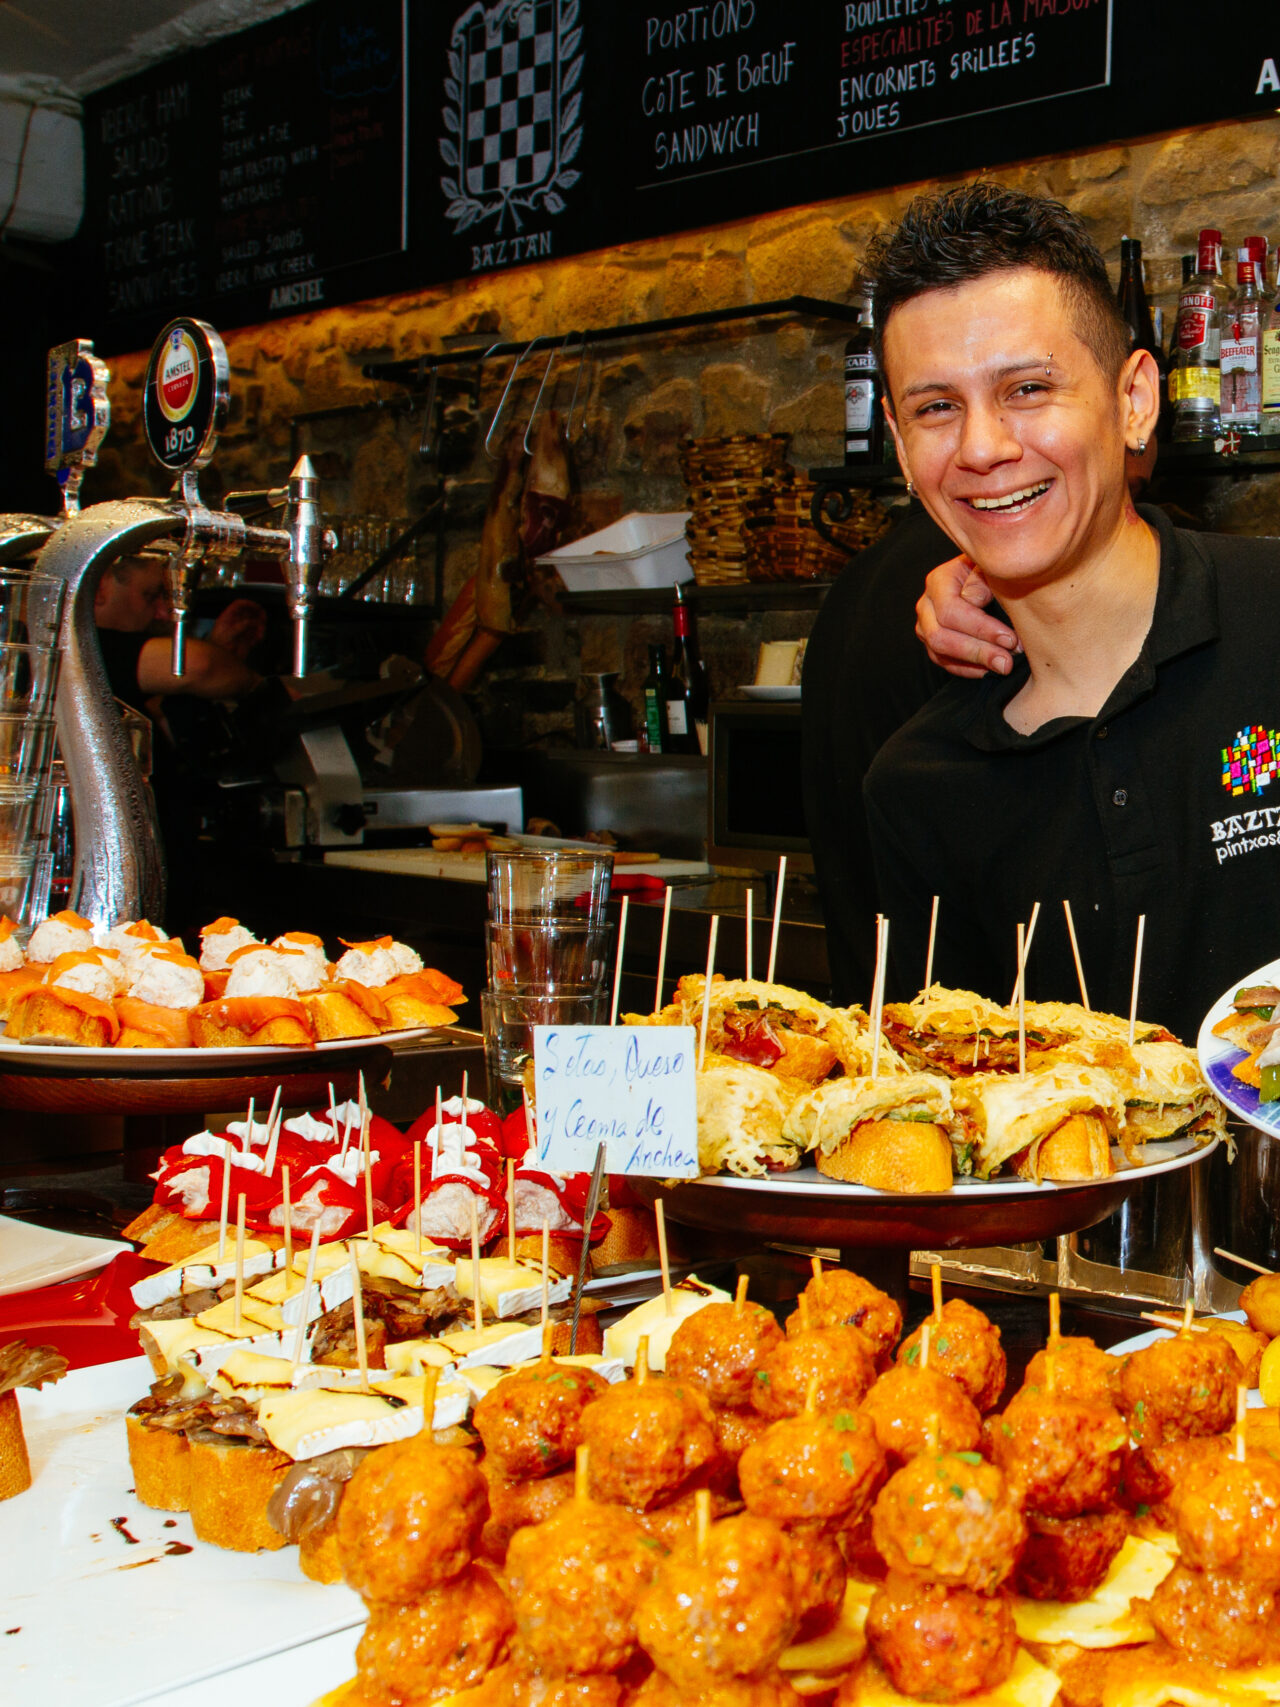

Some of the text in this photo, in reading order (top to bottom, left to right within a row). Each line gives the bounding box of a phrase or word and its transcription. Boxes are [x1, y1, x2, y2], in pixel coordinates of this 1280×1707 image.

[966, 9, 983, 37] DE
[990, 1, 1012, 29] LA
[707, 63, 727, 98] DE
[837, 101, 900, 138] JOUES
[470, 231, 551, 270] BAZTAN
[269, 277, 325, 310] AMSTEL
[165, 360, 191, 379] AMSTEL
[1220, 345, 1255, 359] BEEFEATER
[165, 426, 194, 452] 1870
[625, 1034, 685, 1082] Queso
[541, 1105, 558, 1161] y
[635, 1097, 665, 1138] de
